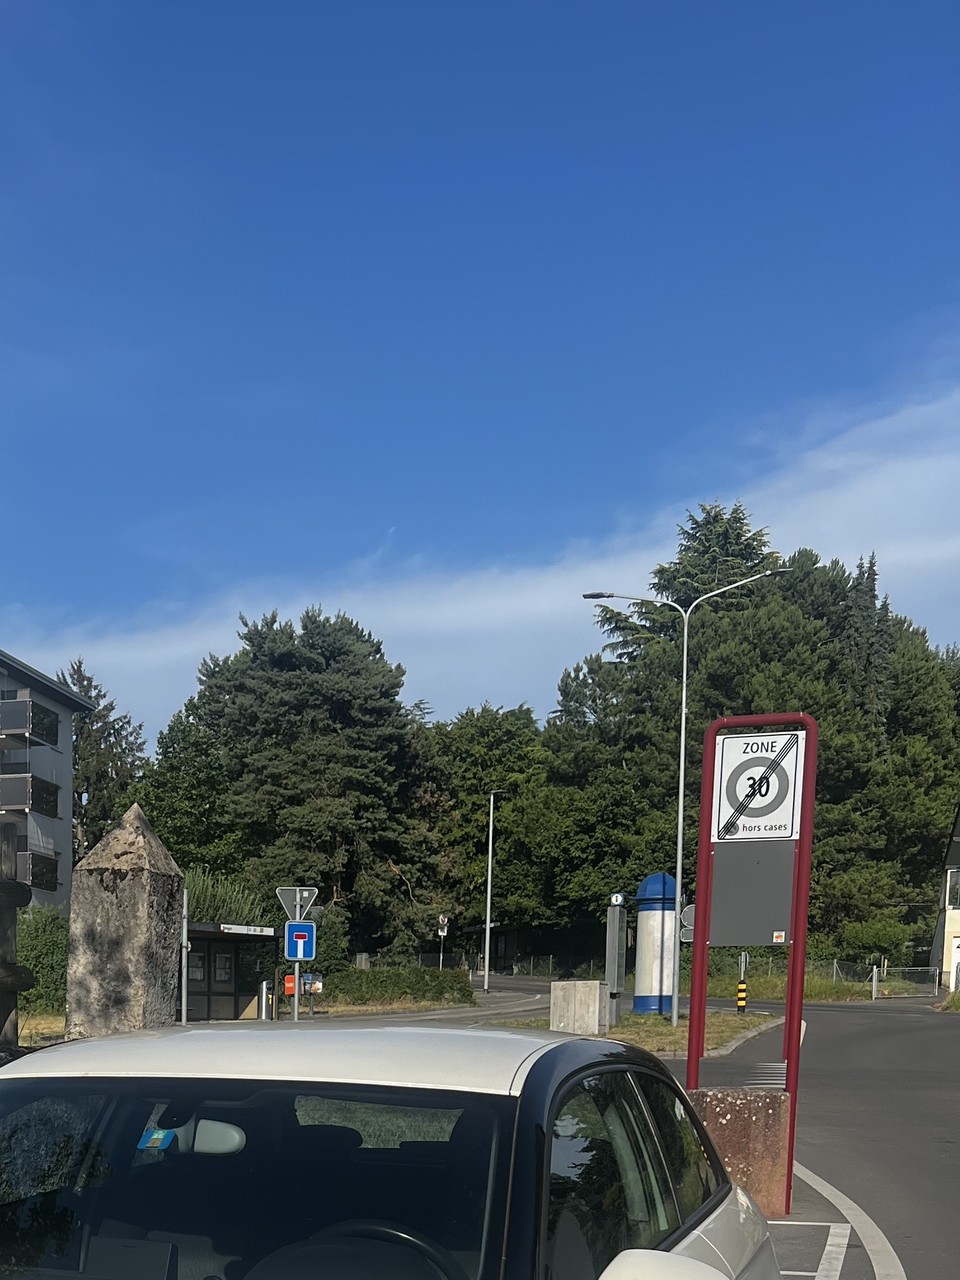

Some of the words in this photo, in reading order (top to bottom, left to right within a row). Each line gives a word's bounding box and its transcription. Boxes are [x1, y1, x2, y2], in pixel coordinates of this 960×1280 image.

[742, 741, 777, 754] ZONE
[745, 776, 770, 797] 30
[742, 823, 761, 832] hors
[763, 823, 788, 831] cases
